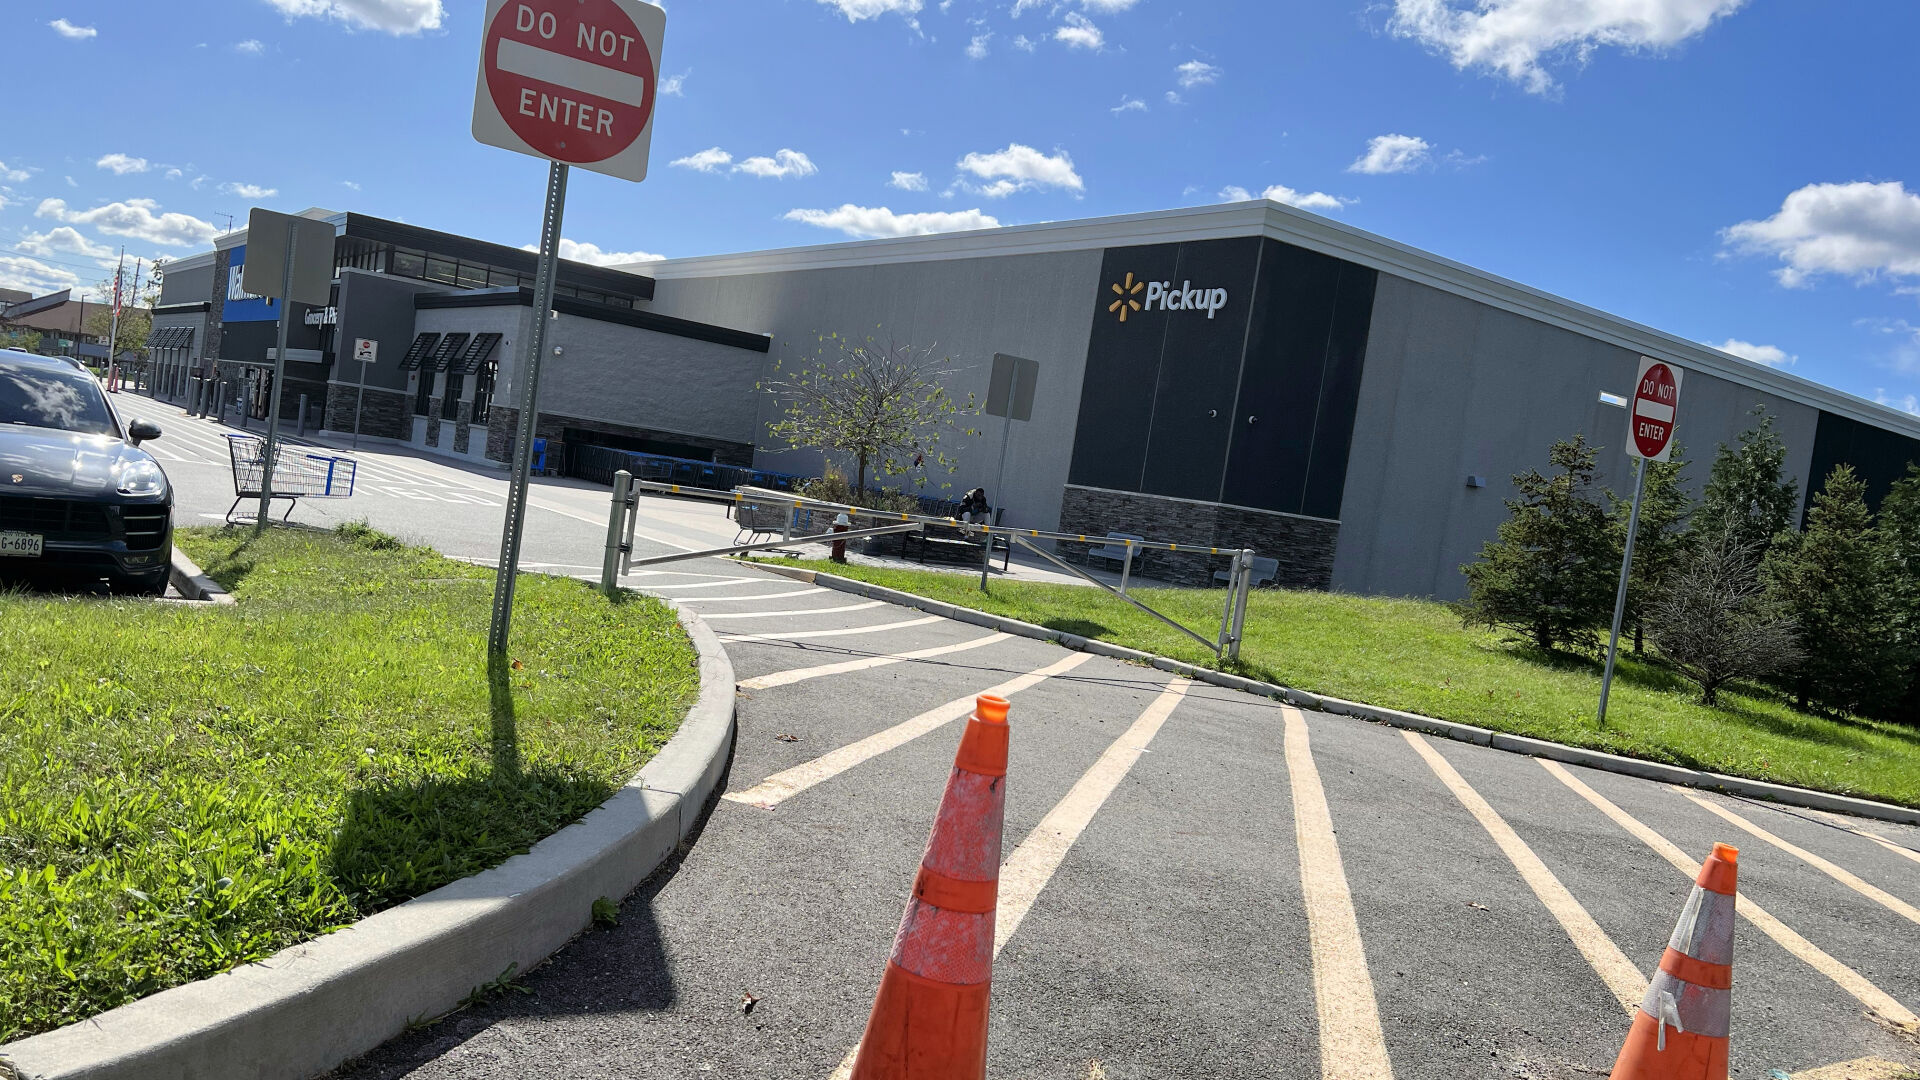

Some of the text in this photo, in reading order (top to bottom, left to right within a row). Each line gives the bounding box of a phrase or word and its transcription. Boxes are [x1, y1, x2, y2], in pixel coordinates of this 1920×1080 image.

[516, 4, 635, 62] DO NOT
[519, 87, 614, 137] ENTER
[1144, 280, 1228, 319] Pickup
[1642, 379, 1674, 400] DO NOT
[1638, 422, 1665, 440] ENTER
